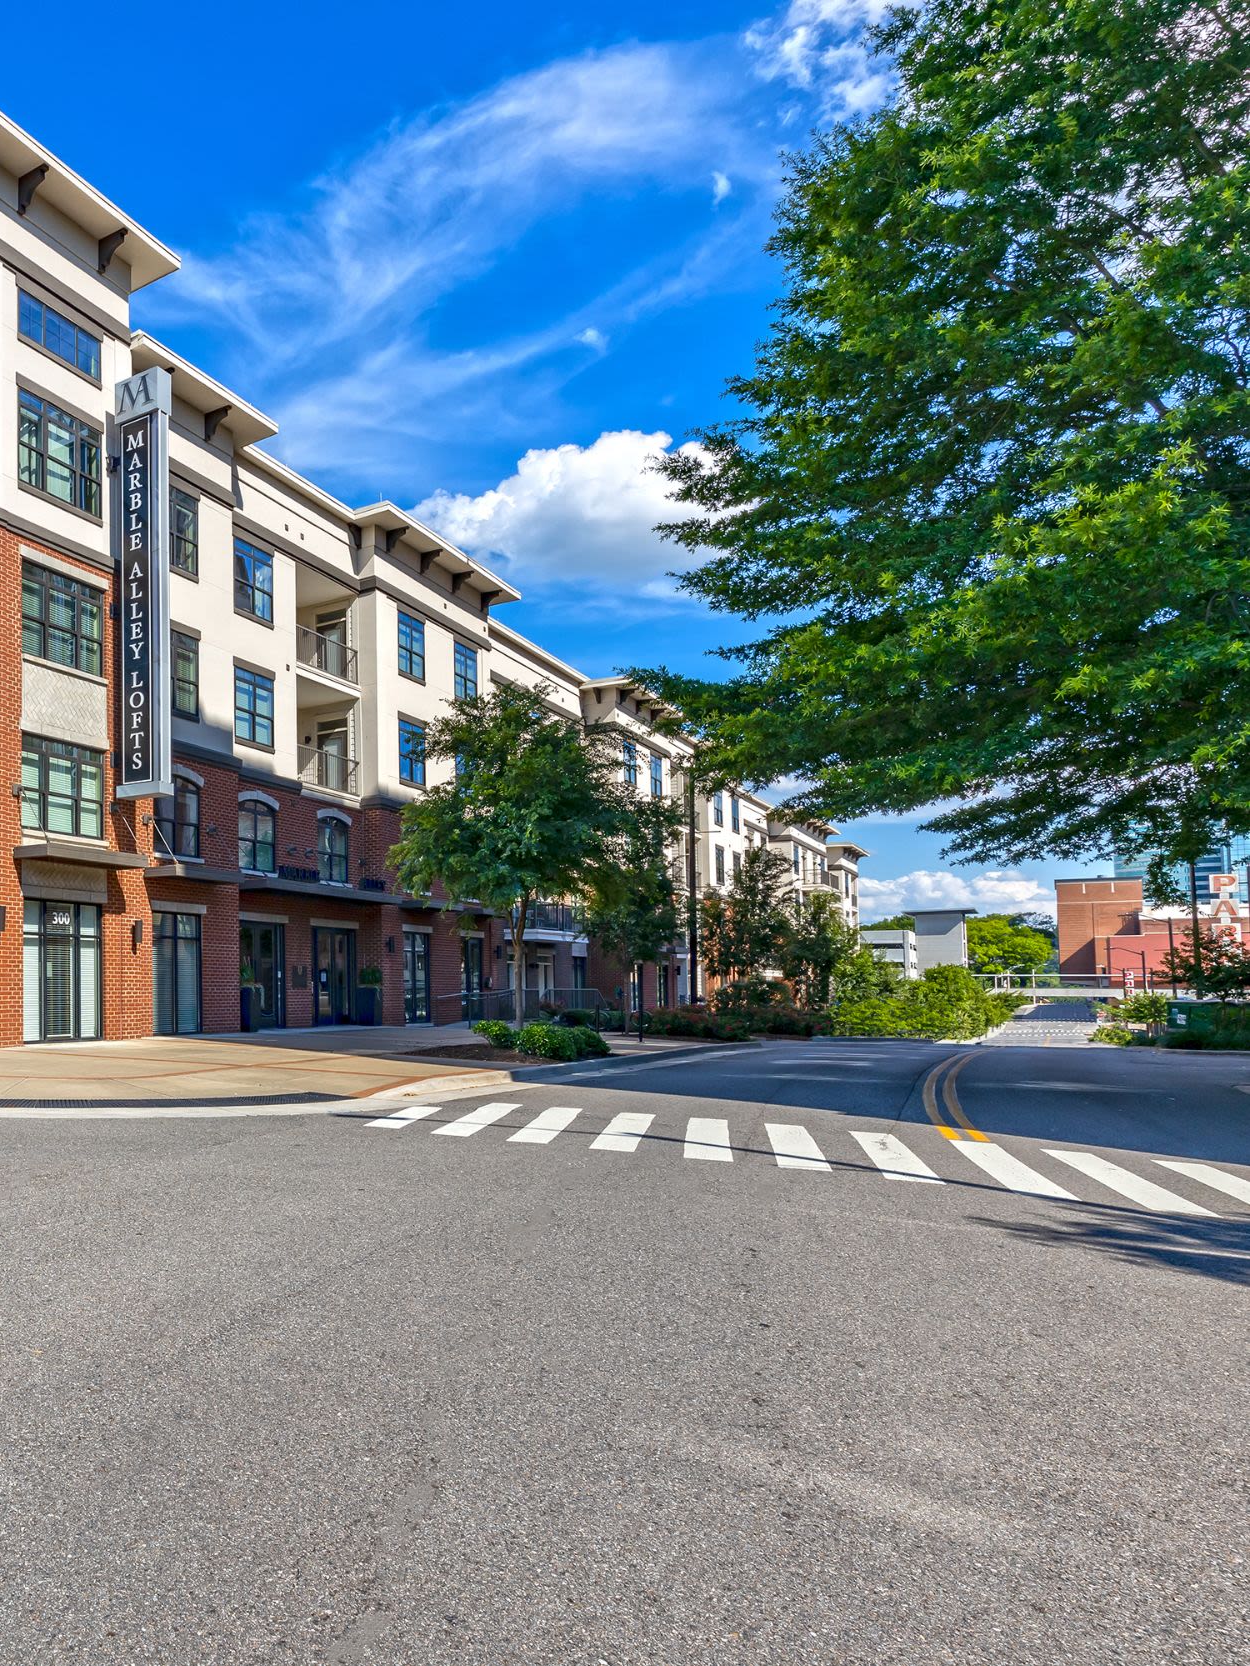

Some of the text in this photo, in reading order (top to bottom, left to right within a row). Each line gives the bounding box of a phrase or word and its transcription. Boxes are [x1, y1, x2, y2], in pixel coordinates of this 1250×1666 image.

[126, 430, 144, 770] MARBLE ALLEY LOFTS
[52, 912, 70, 925] 300
